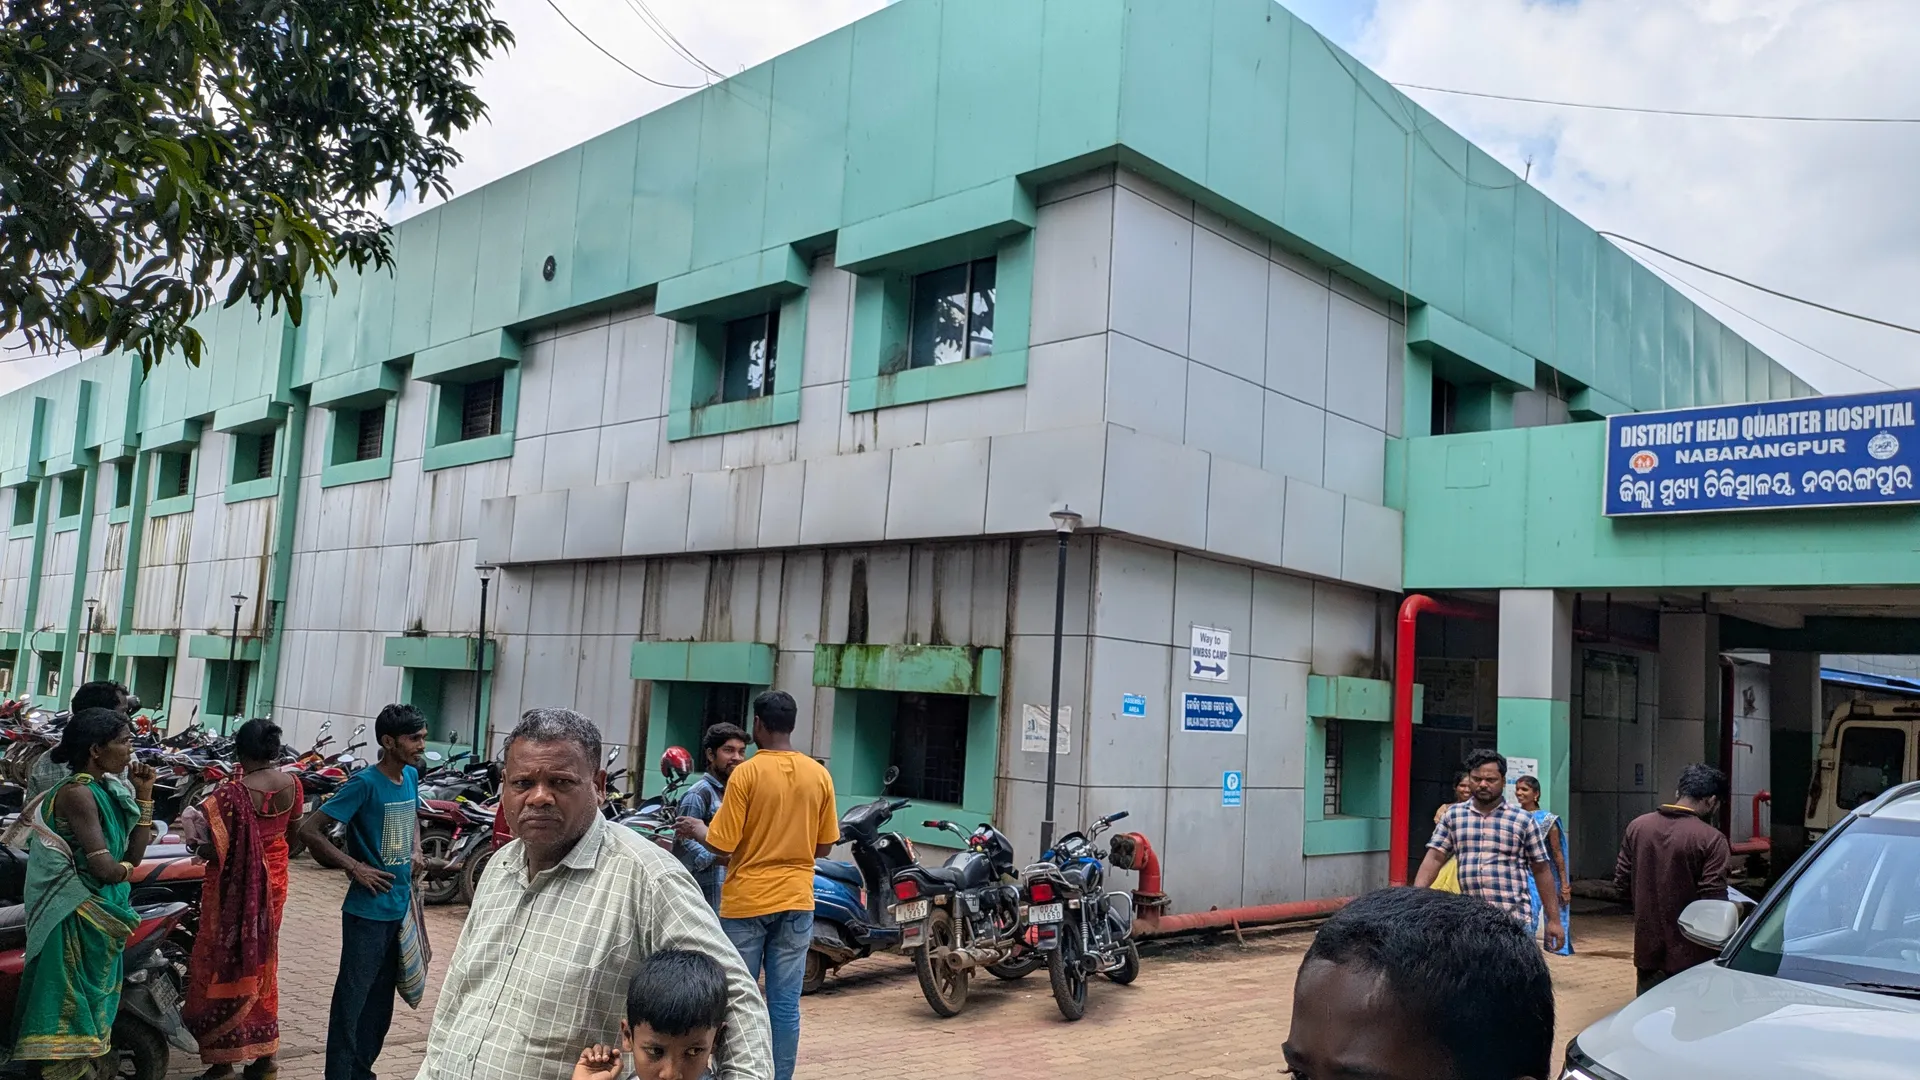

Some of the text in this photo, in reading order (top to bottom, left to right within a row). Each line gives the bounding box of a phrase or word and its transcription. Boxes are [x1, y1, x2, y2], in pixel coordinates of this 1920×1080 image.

[1620, 402, 1914, 448] DISTRICT HEAD QUARTER HOSPITAL
[1675, 438, 1846, 464] NABARANGPUR
[1619, 474, 1654, 509] ଜିଲ୍ଲା
[1660, 477, 1699, 506] ମୁଖ୍ୟ
[1199, 632, 1221, 646] Way to
[1212, 649, 1228, 661] CAMP
[1037, 911, 1061, 920] L1650
[1039, 905, 1058, 913] OD24
